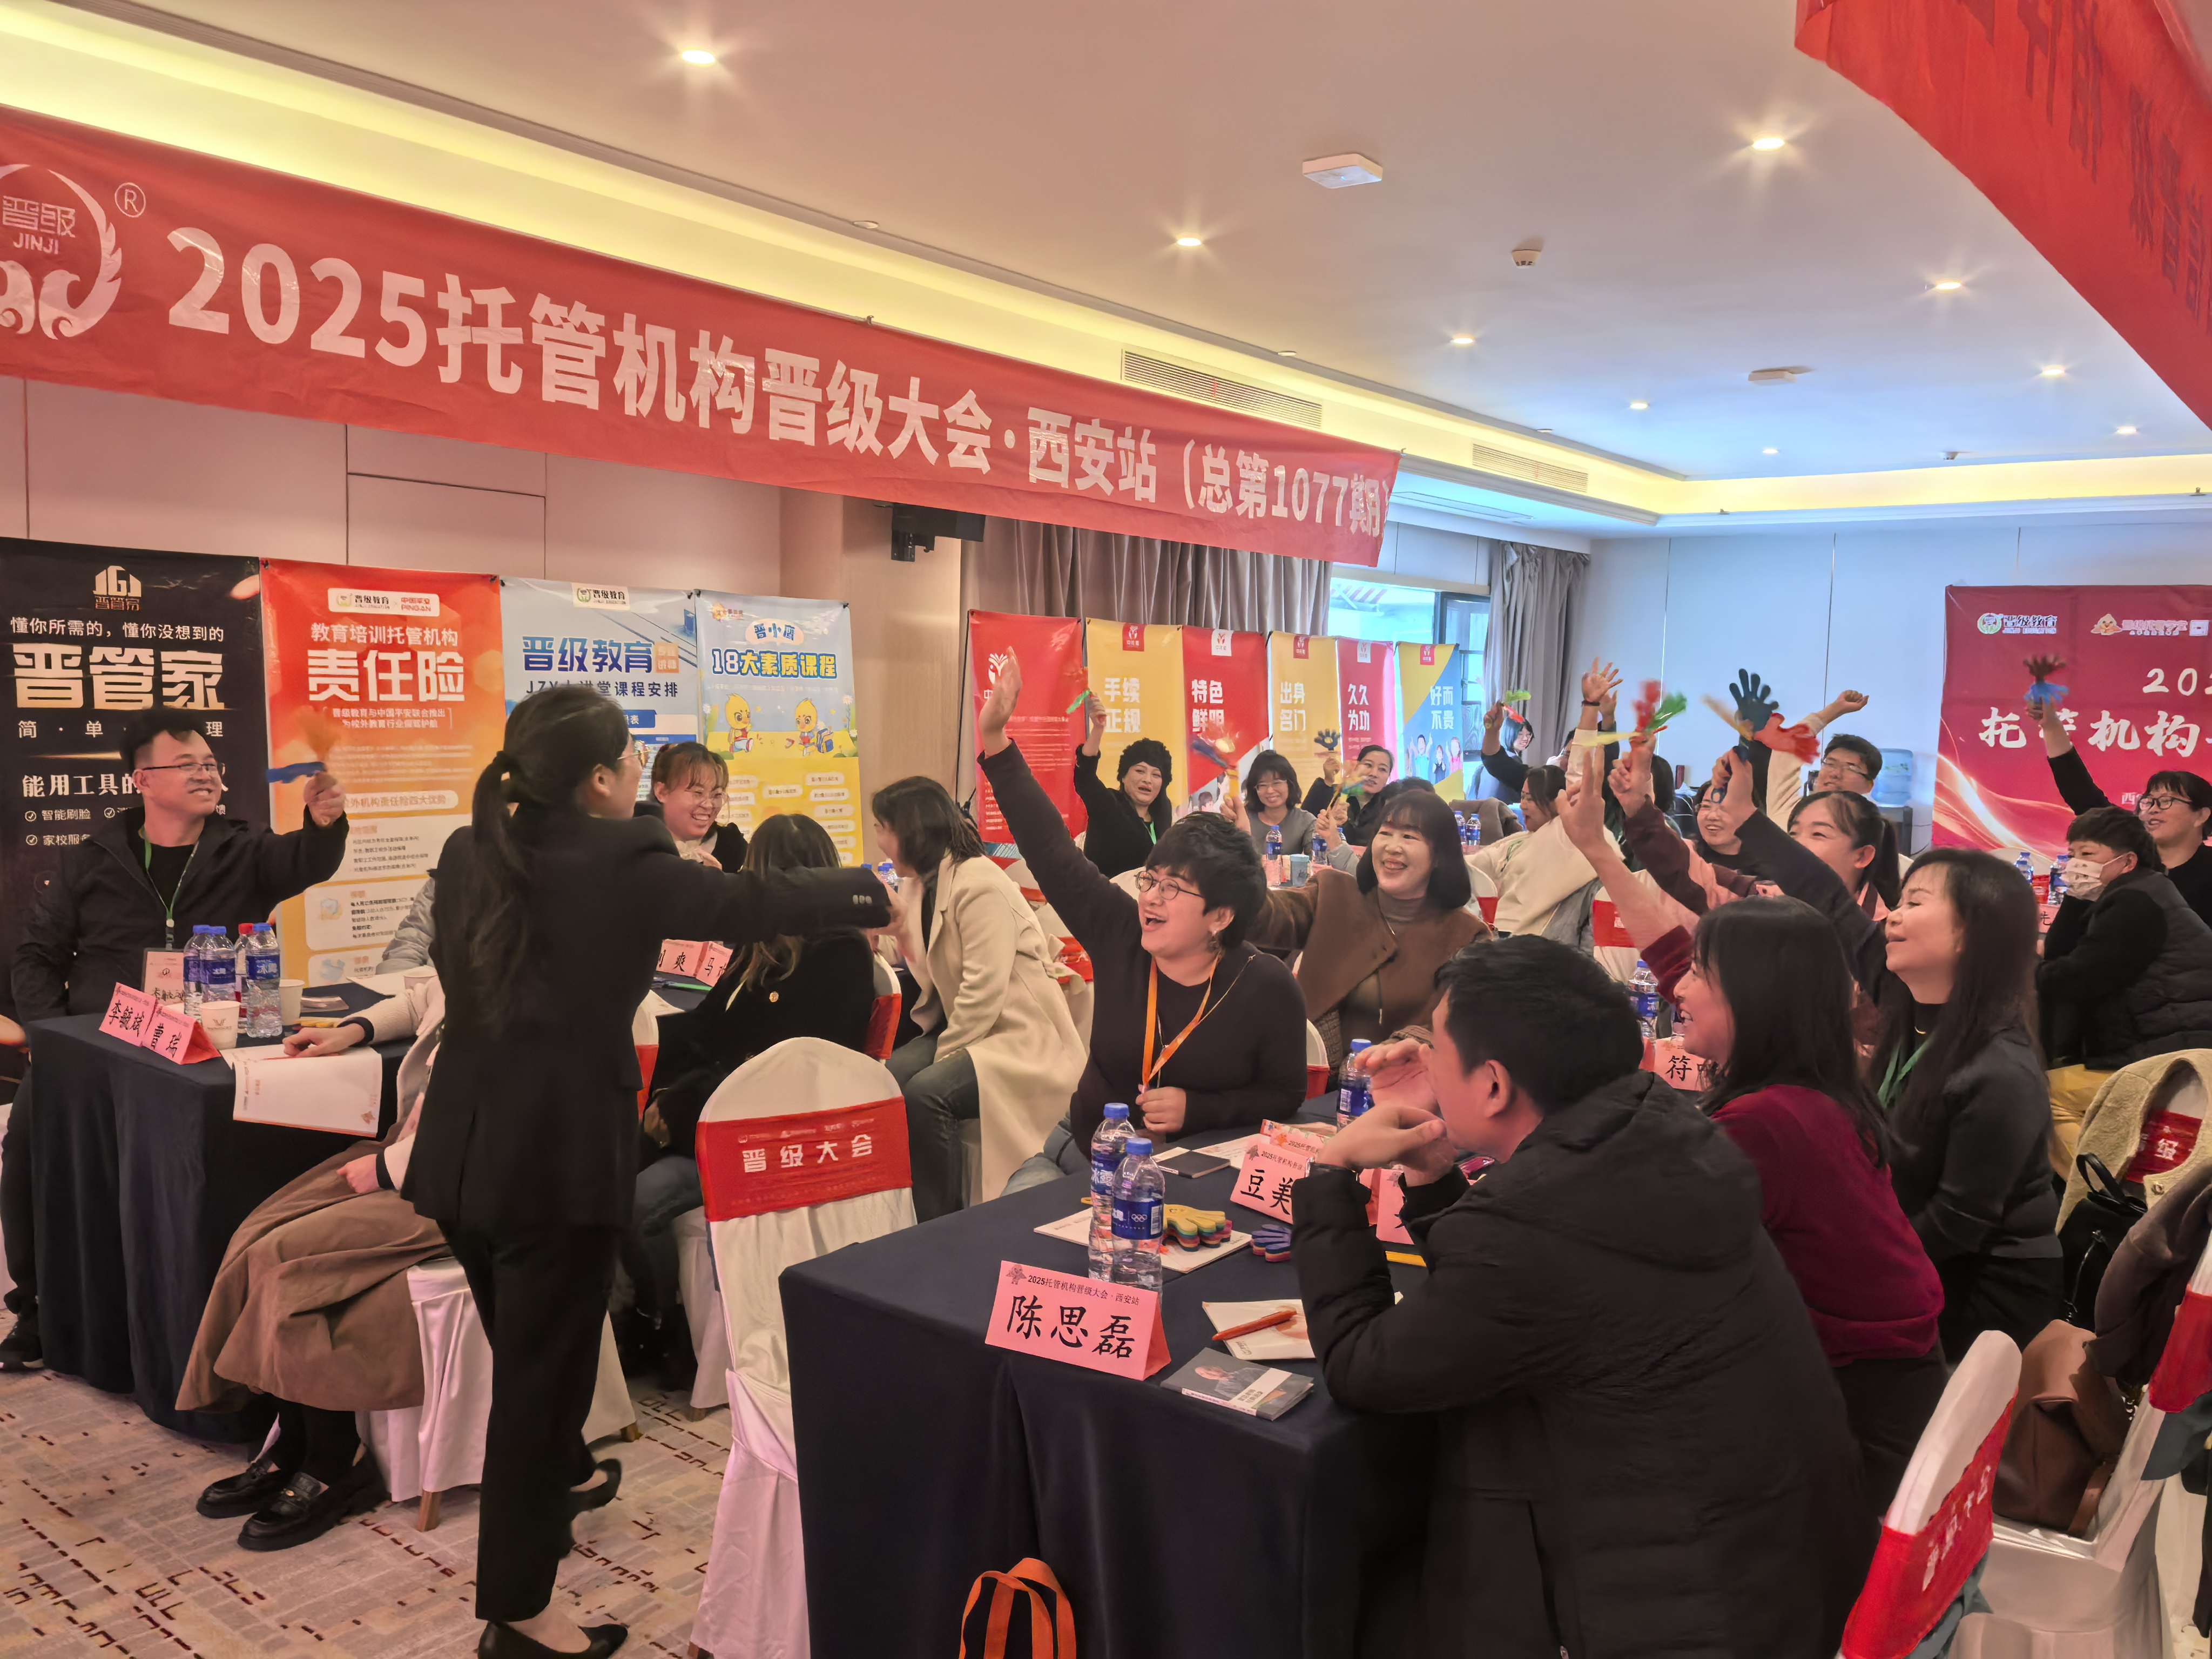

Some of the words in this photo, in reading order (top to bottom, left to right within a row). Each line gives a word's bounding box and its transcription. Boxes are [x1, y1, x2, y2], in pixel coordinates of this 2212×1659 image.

[13, 232, 59, 254] JINJI
[311, 623, 458, 646] 教育培训托管机构
[523, 636, 652, 673] 晋级教育
[712, 649, 837, 678] 18大素质课程
[13, 643, 225, 710] 晋管家
[308, 649, 465, 702] 责任险
[1104, 677, 1140, 703] 手续
[1191, 679, 1224, 704] 特色
[1280, 682, 1305, 704] 出身
[1348, 684, 1369, 705] 久久
[1430, 686, 1453, 706] 好而
[1105, 709, 1141, 733] 正规
[1192, 709, 1225, 732] 鲜明
[1280, 709, 1306, 731] 名门
[1348, 709, 1370, 731] 为功
[1431, 710, 1454, 730] 不贵
[742, 1134, 872, 1173] 晋级大会
[1007, 1296, 1135, 1359] 陈思磊
